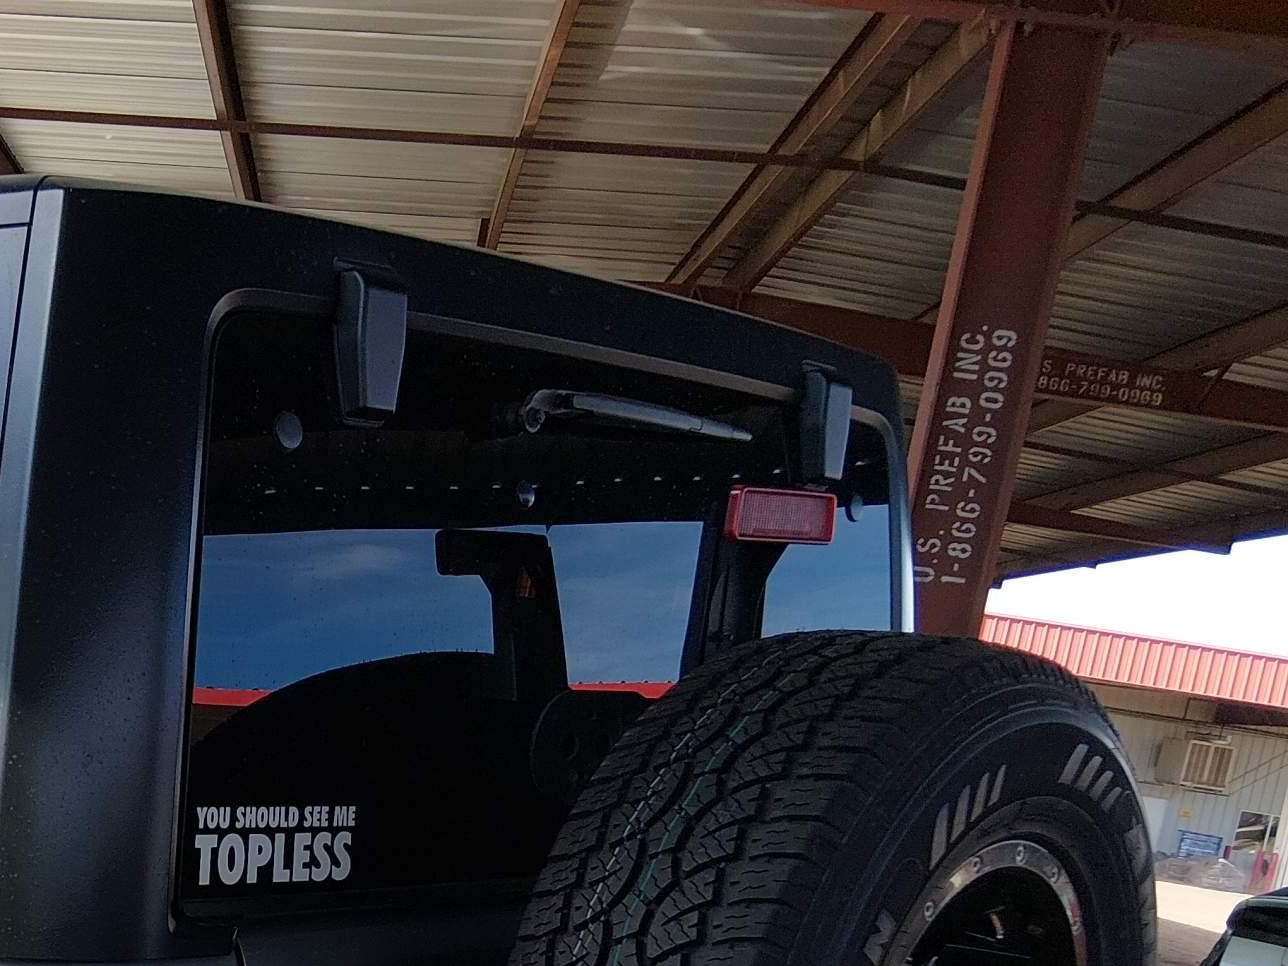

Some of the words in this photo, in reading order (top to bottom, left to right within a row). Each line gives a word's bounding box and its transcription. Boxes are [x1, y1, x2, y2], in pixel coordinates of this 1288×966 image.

[1065, 362, 1128, 385] PREFAB
[1135, 373, 1166, 391] INC.
[925, 395, 972, 511] PREFAB
[953, 324, 989, 381] INC.
[940, 328, 1018, 584] 1-866-799-0969
[196, 806, 231, 829] YOU
[235, 806, 299, 829] SHOULD
[304, 805, 329, 827] SEE
[332, 805, 357, 827] ME
[194, 830, 353, 886] TOPLESS
